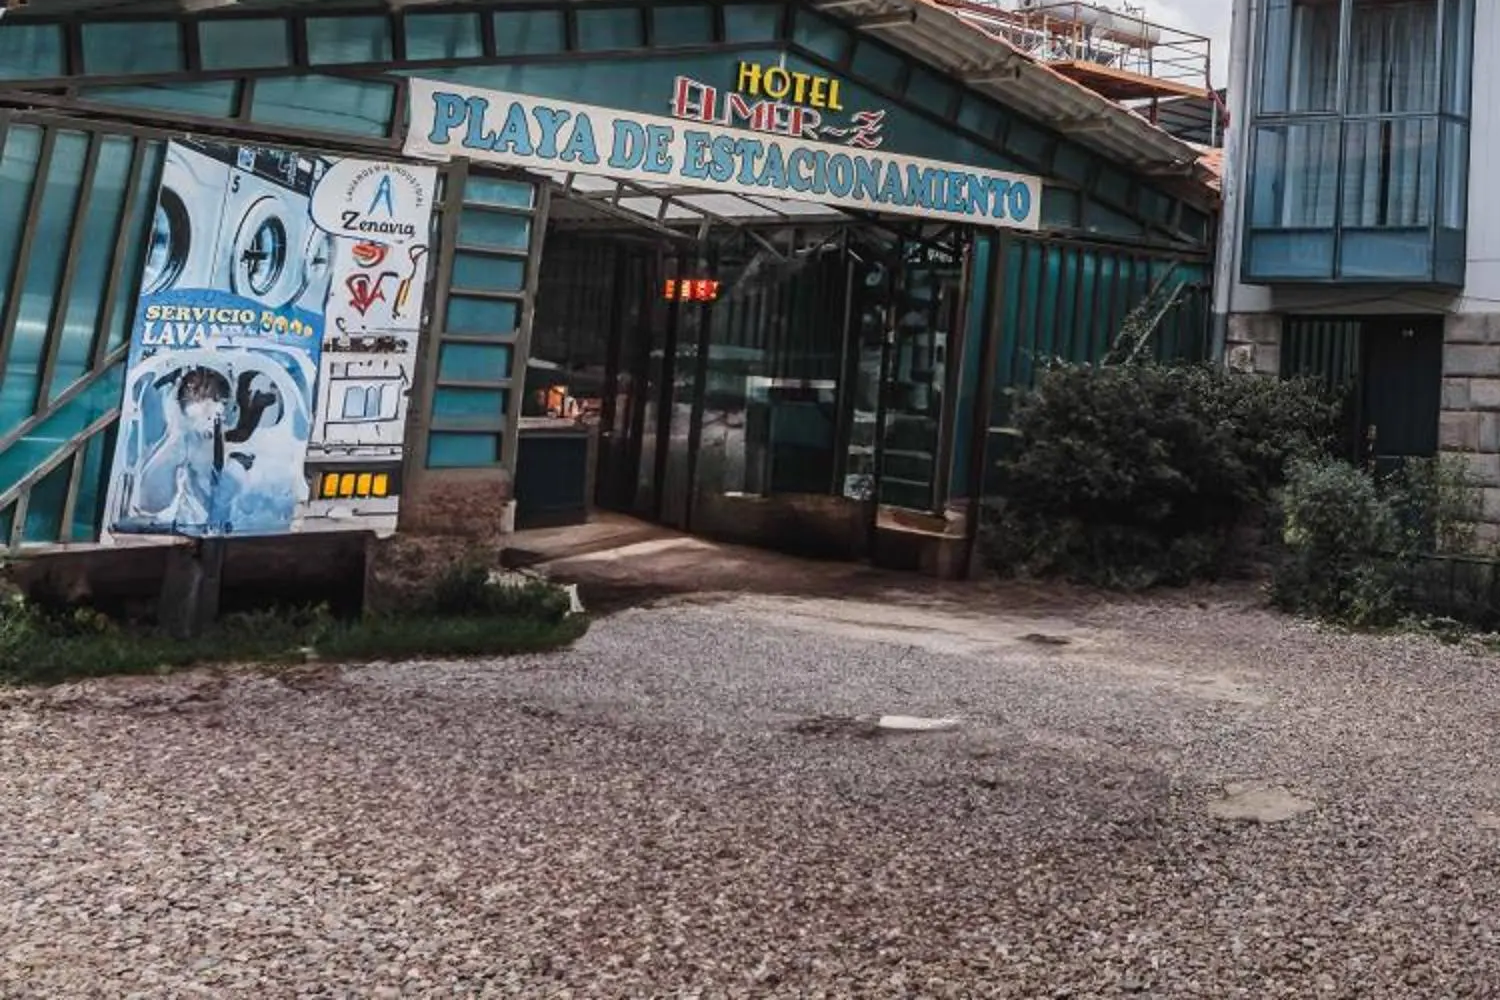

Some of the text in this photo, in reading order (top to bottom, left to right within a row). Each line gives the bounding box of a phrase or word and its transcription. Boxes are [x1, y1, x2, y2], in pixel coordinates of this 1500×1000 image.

[738, 60, 844, 111] HOTEL
[427, 91, 1032, 222] PLAYA DE ESTACIONAMIENTO
[145, 305, 256, 324] SERVICIO
